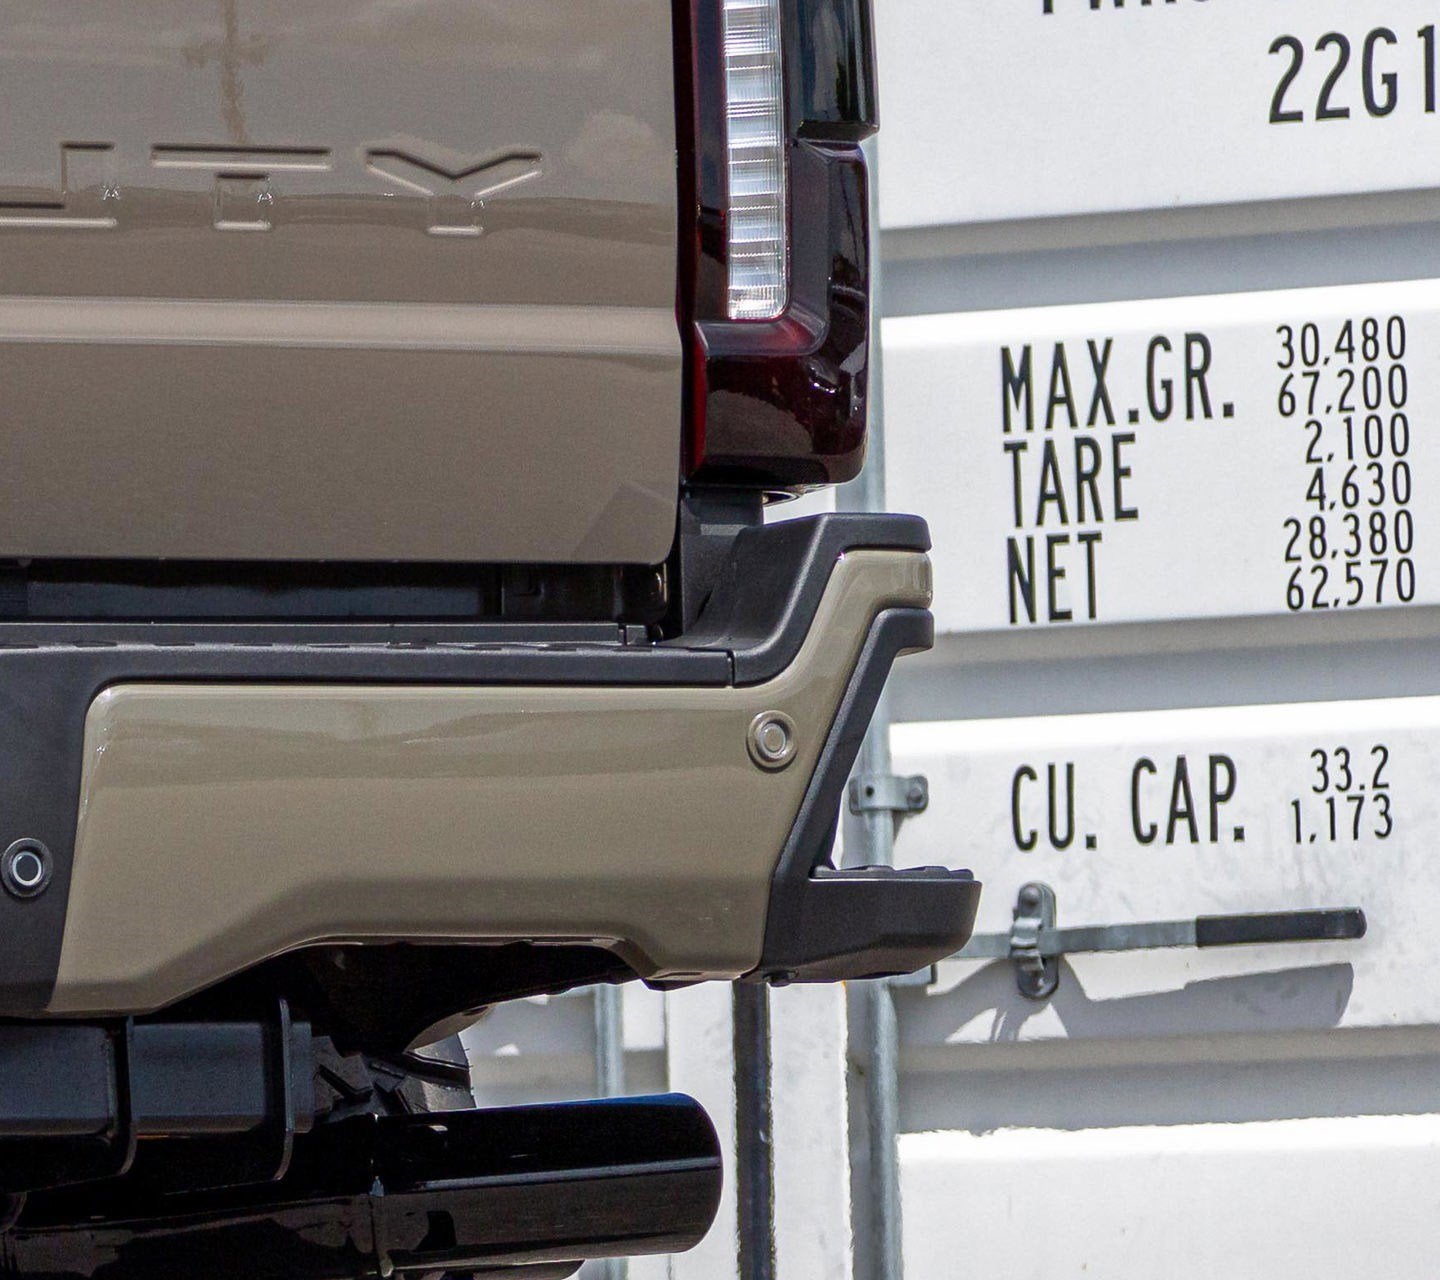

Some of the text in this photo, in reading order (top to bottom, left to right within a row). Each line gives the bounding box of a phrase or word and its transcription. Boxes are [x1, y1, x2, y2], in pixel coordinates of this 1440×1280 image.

[1267, 23, 1437, 125] 22G1
[1275, 314, 1407, 371] 30,480
[1277, 363, 1409, 418] 67,200
[1304, 412, 1411, 464] 2,100
[1003, 432, 1140, 529] TARE
[1305, 460, 1412, 512] 4,630
[1282, 508, 1415, 563] 28,380
[1007, 531, 1103, 626] NET
[1285, 557, 1417, 612] 62,570
[1309, 744, 1391, 794] 33.2
[1010, 752, 1247, 853] CU. CAP.
[1290, 792, 1394, 844] 1,173
